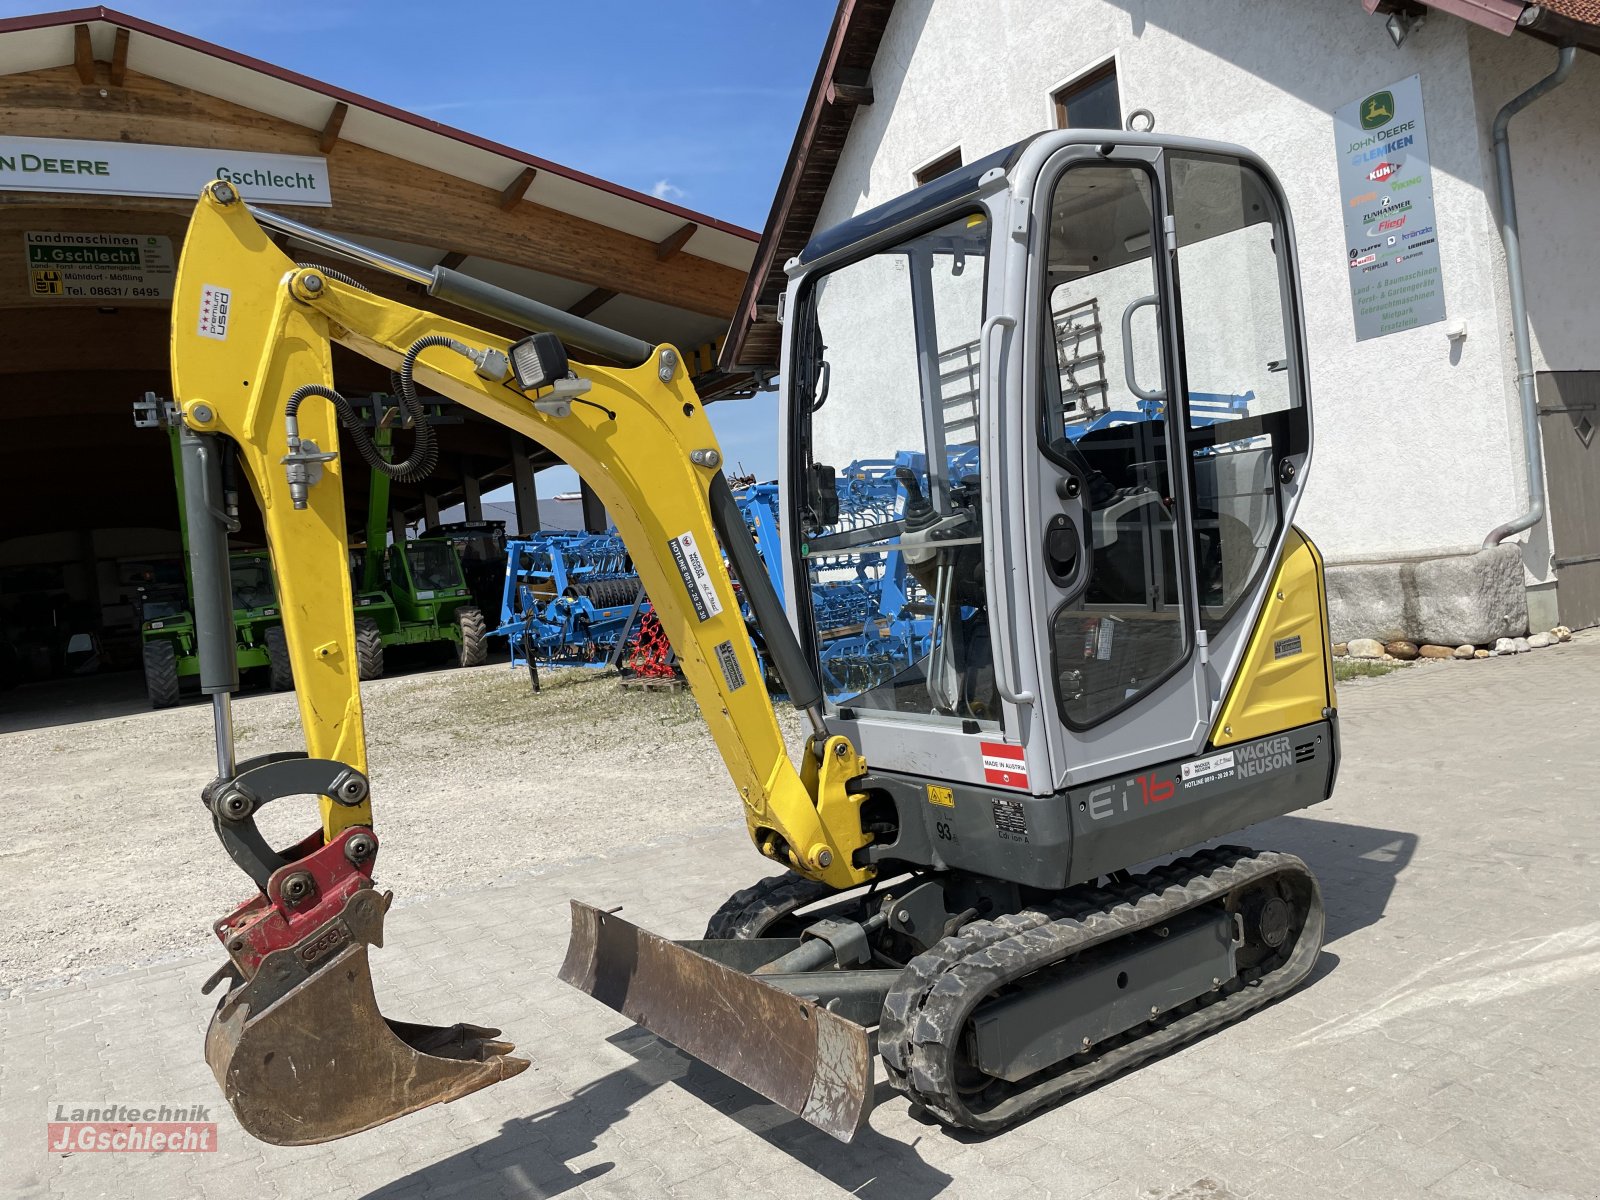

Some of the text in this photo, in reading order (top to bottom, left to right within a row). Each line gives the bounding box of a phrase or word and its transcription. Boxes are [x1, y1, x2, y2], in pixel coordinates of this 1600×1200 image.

[1346, 120, 1415, 154] JOHN DEERE
[1363, 135, 1413, 161] LEMKEN
[21, 154, 110, 176] DEERE
[1369, 164, 1397, 180] KUHN
[216, 167, 316, 190] Gschlecht
[1391, 176, 1422, 192] VIKING
[1363, 200, 1411, 220] ZUNHAMMER
[1378, 214, 1406, 231] Fliegl
[27, 232, 139, 245] Landmaschinen
[1402, 226, 1432, 240] kränzle
[1407, 238, 1435, 250] LIEBHERR
[33, 248, 136, 263] J. Gschlecht
[64, 273, 103, 281] Mühldorf
[109, 274, 144, 283] Mößling
[1353, 285, 1370, 296] Land
[1384, 266, 1438, 286] Baumaschinen
[65, 286, 87, 296] Tel.
[89, 287, 122, 296] 08631
[132, 288, 160, 297] 6495
[1387, 279, 1435, 297] Gartengeräte
[1360, 290, 1435, 315] Gebrauchtmaschinen
[210, 291, 220, 334] premium
[217, 292, 229, 336] used
[1382, 307, 1413, 320] Mietpark
[1380, 317, 1418, 332] Ersatzteile
[670, 541, 687, 572] HOTLINE
[683, 572, 694, 589] 0810
[692, 592, 699, 602] 20
[695, 601, 703, 611] 20
[699, 610, 707, 620] 30
[1234, 736, 1291, 763] WACKER
[984, 760, 999, 768] MADE
[1005, 763, 1026, 771] AUSTRIA
[1237, 751, 1292, 780] NEUSON
[1184, 777, 1204, 789] HOTLINE
[936, 821, 952, 841] 93
